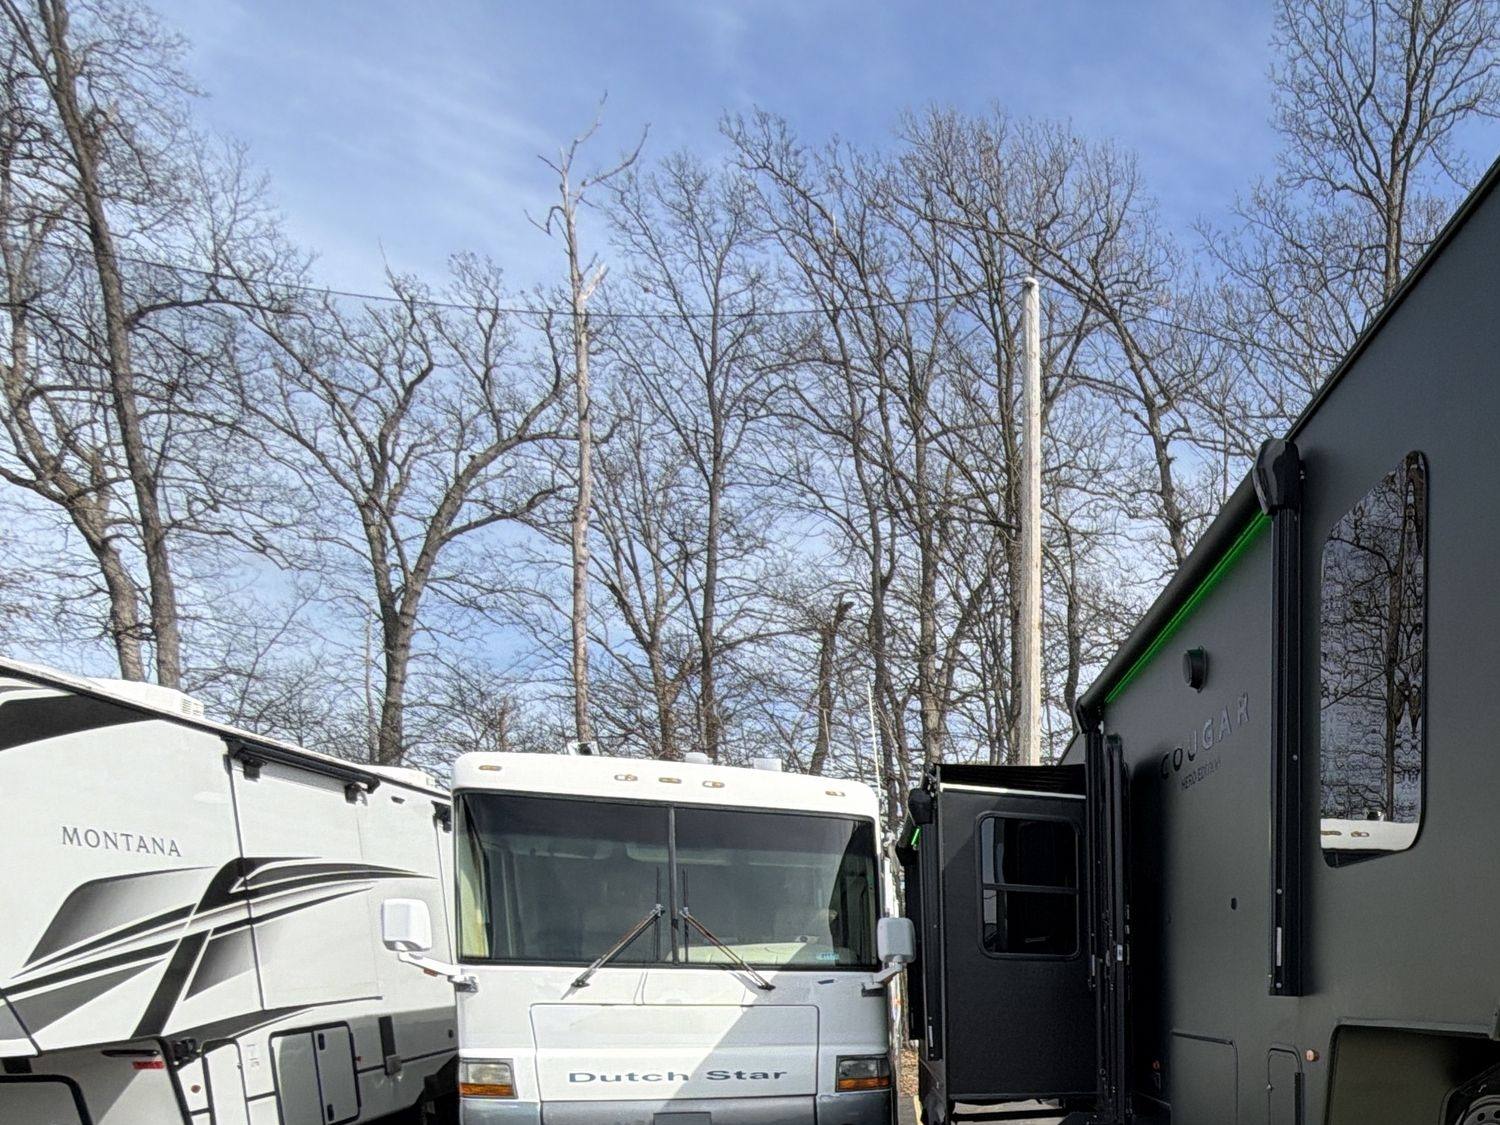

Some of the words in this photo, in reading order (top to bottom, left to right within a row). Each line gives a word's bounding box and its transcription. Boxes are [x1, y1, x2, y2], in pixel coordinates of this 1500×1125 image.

[1161, 692, 1249, 780] COUGAR
[62, 826, 182, 857] MONTANA
[568, 1071, 690, 1083] Dutch
[706, 1070, 788, 1081] Star
